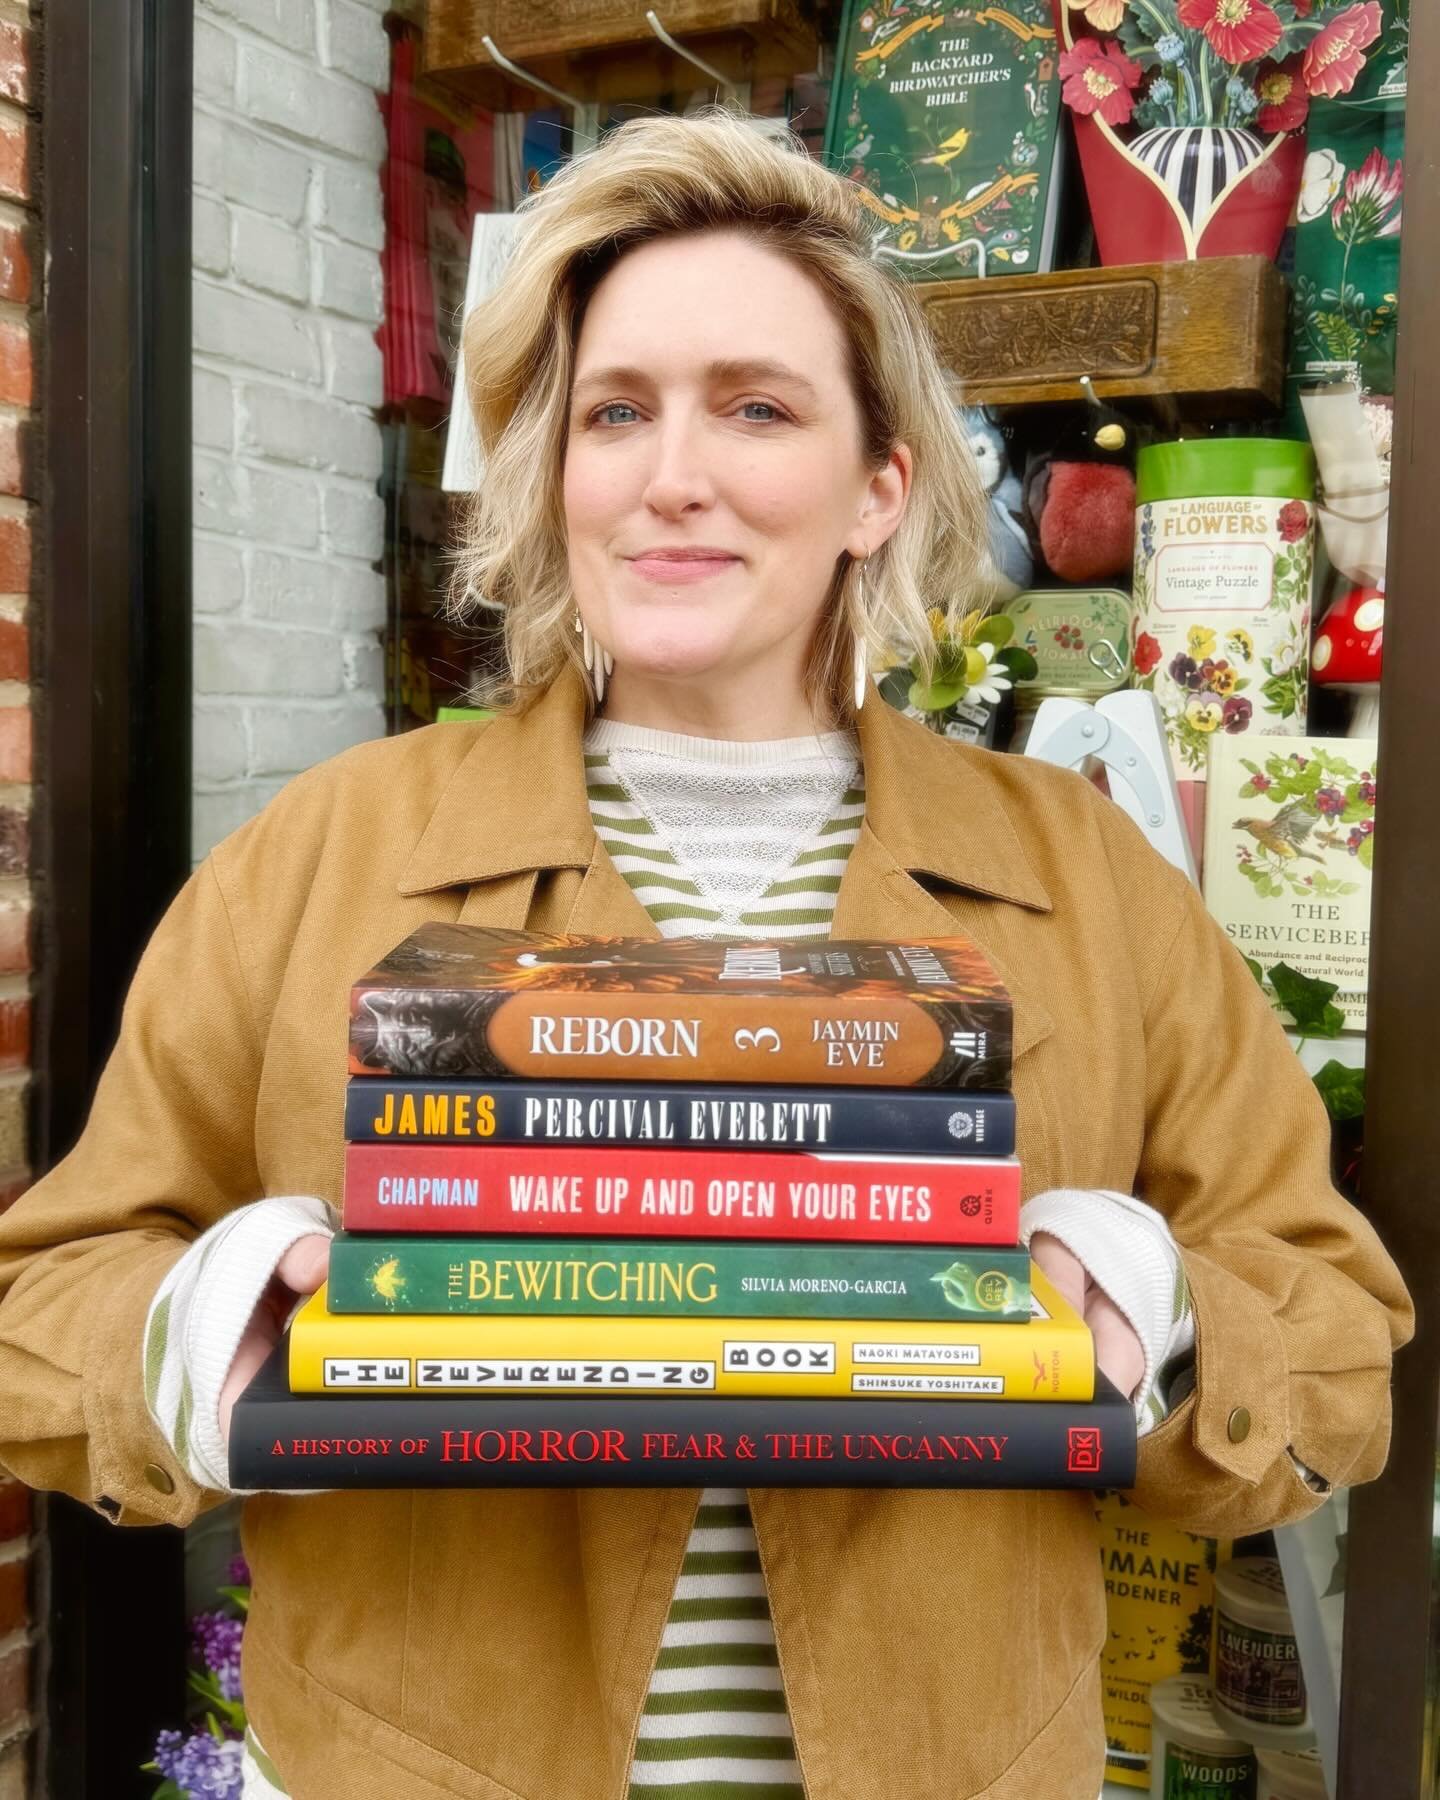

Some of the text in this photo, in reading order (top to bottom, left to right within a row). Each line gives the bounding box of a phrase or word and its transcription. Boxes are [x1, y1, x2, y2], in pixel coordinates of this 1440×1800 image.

[940, 38, 970, 53] THE
[911, 53, 994, 74] BACKYARD
[889, 68, 1012, 94] BIRDWATCHER'S
[925, 91, 969, 107] BIBLE
[1181, 502, 1252, 515] LANGUAGE
[1163, 515, 1269, 537] FLOWERS
[1165, 575, 1259, 591] Vintage Puzzle
[1291, 903, 1340, 920] THE
[1248, 950, 1367, 965] Abundance and Reciproc
[1334, 967, 1364, 977] World
[529, 1015, 782, 1058] REBORN 3
[811, 1019, 900, 1043] JAYMIN
[826, 1042, 885, 1068] EVE
[977, 1031, 987, 1060] MIRA
[374, 1093, 832, 1143] JAMES PERCIVAL EVERETT
[975, 1108, 985, 1143] VINTAGE
[377, 1175, 932, 1222] CHAPMAN WAKE UP AND OPEN YOUR EYES
[984, 1188, 993, 1225] QUIRK
[447, 1260, 718, 1303] THE BEWITCHING
[741, 1277, 908, 1295] SILVIA MORENO-GARCIA
[985, 1279, 993, 1301] DEL
[994, 1279, 1002, 1301] REY
[858, 1347, 975, 1361] NAOKI MATAYOSHI
[329, 1347, 829, 1385] THE NEVERENDING BOOK
[1051, 1350, 1061, 1393] NORTON
[858, 1377, 998, 1391] SHINSUKE YOSHITAKE
[272, 1430, 1009, 1463] A HISTORY OF HORROR FEAR & THE UNCANNY
[1077, 1432, 1093, 1466] DK
[1115, 1527, 1151, 1547] THE
[1100, 1545, 1201, 1588] MANE
[1219, 1628, 1297, 1660] LAVENDER
[1179, 1761, 1249, 1784] WOODS
